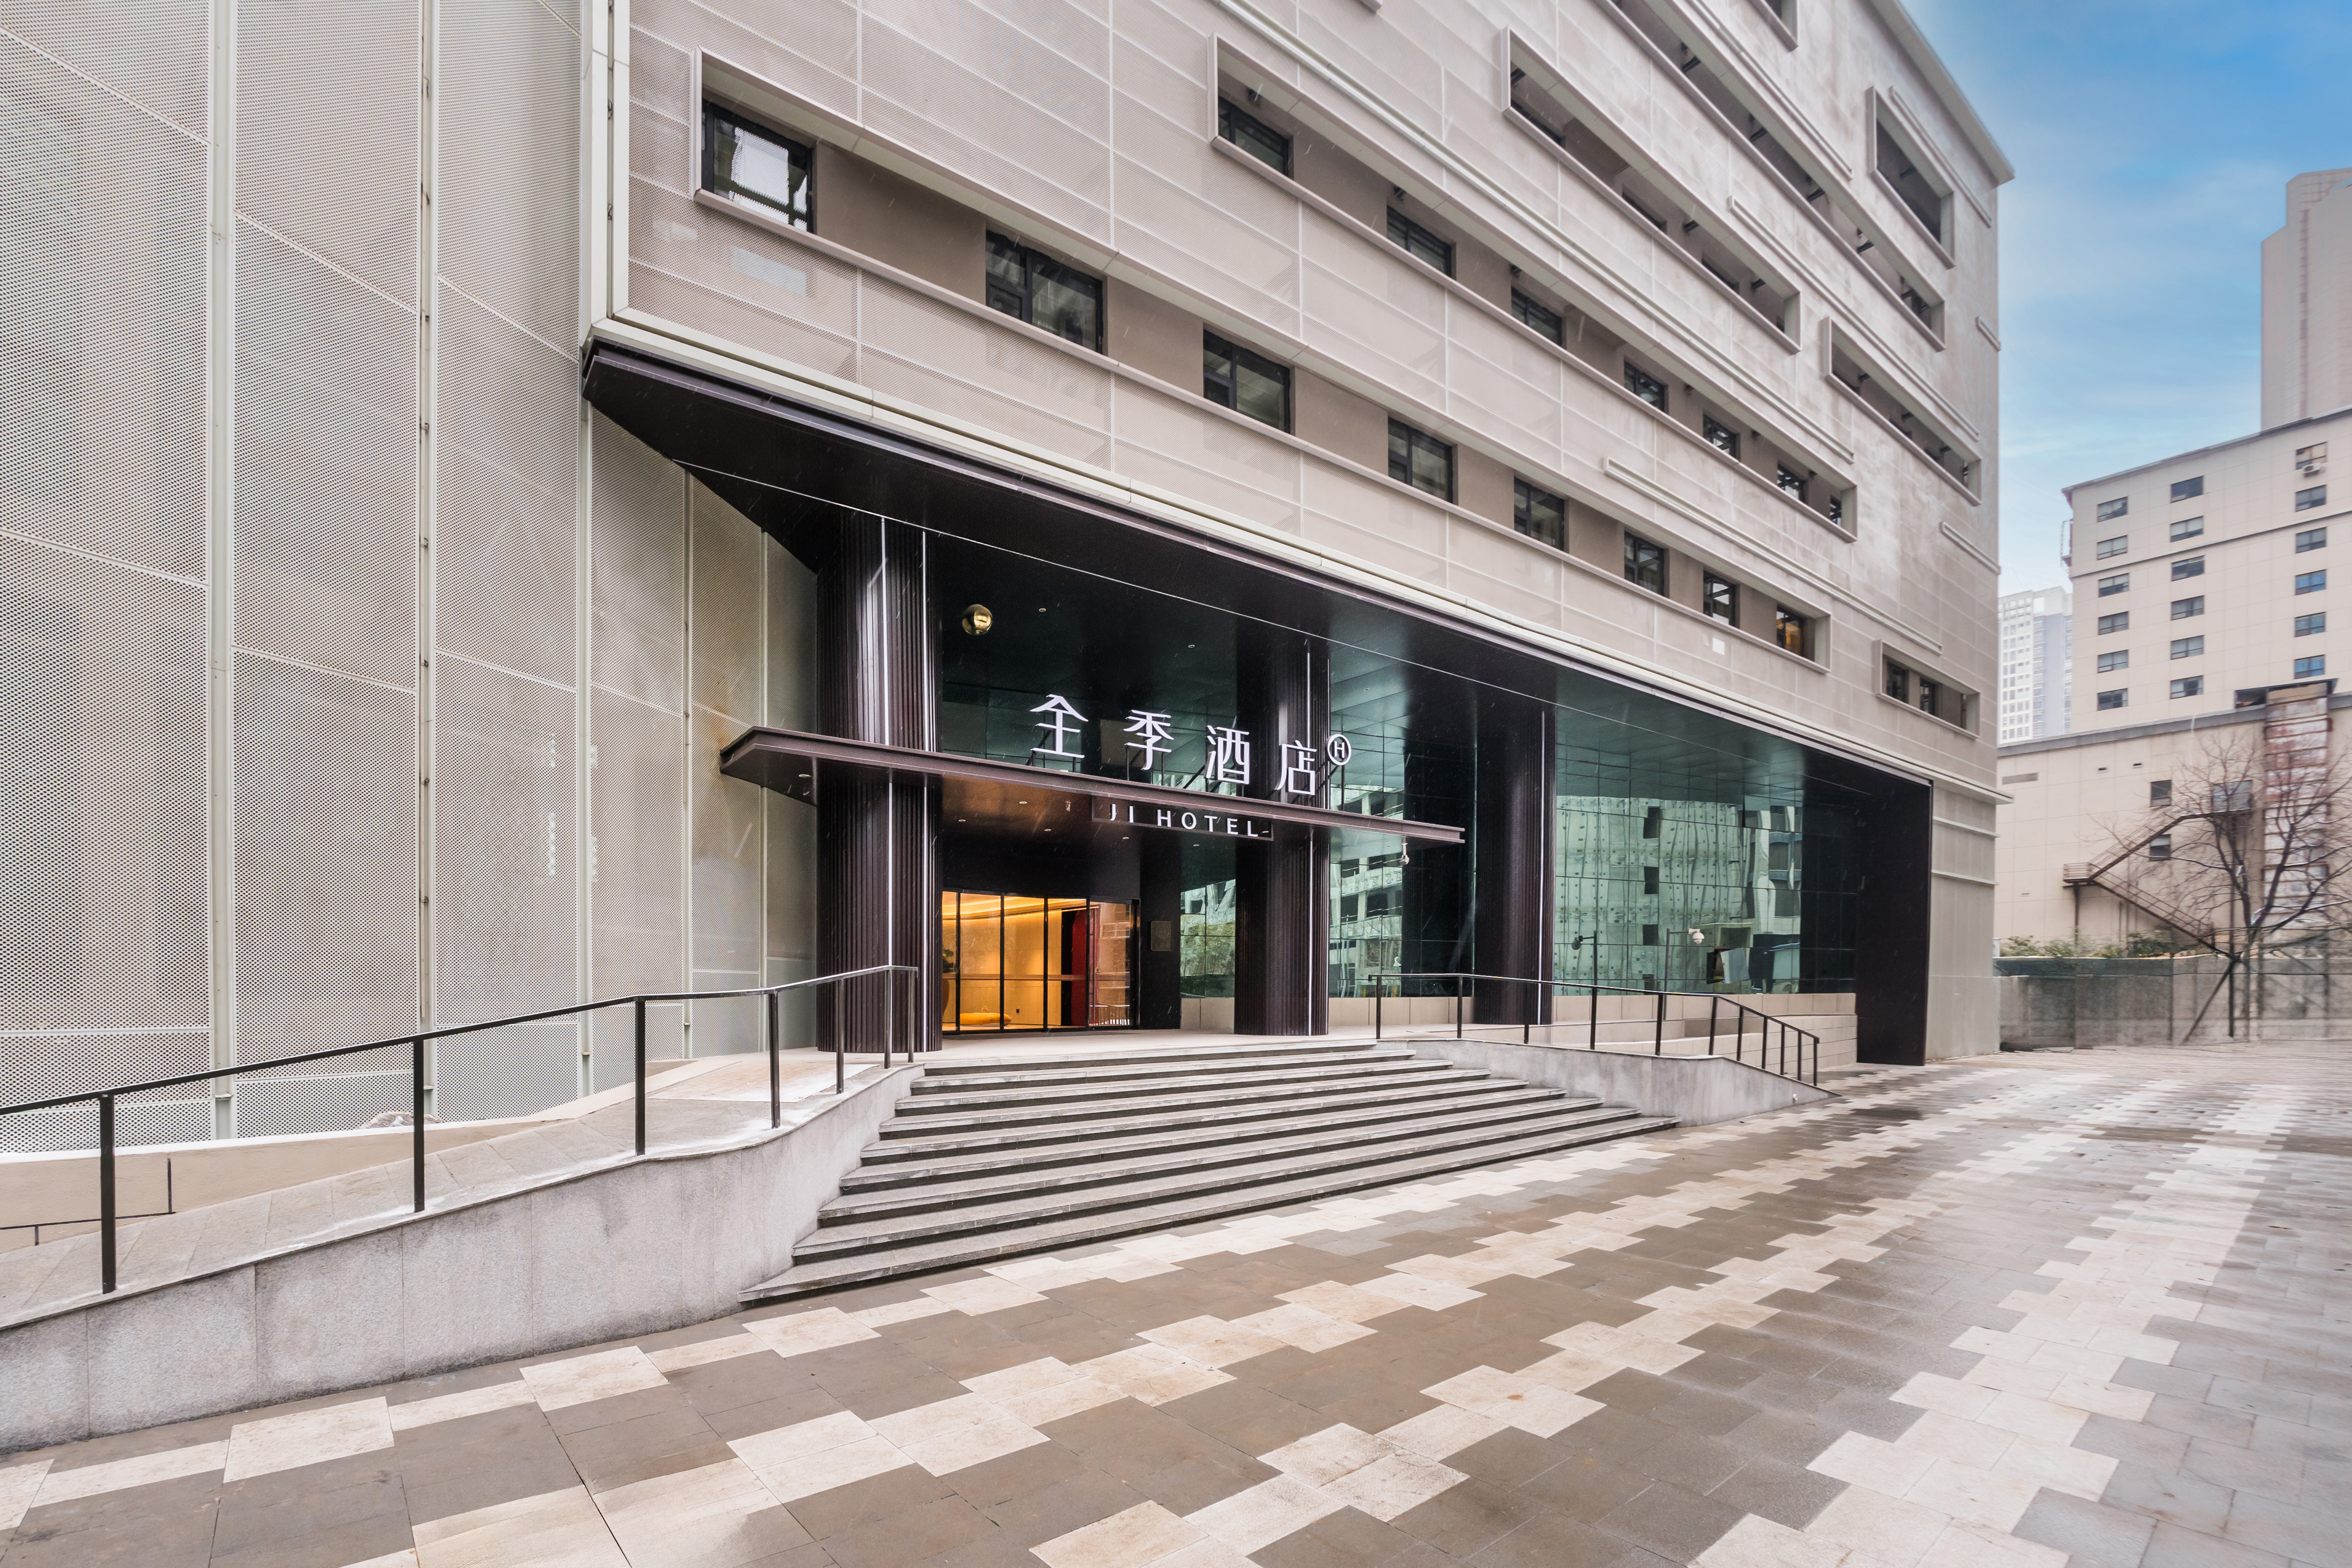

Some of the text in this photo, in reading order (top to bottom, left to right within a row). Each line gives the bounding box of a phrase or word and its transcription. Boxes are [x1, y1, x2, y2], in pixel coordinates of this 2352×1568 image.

[1029, 694, 1317, 796] 全季酒店
[1109, 804, 1258, 837] JI HOTEL
